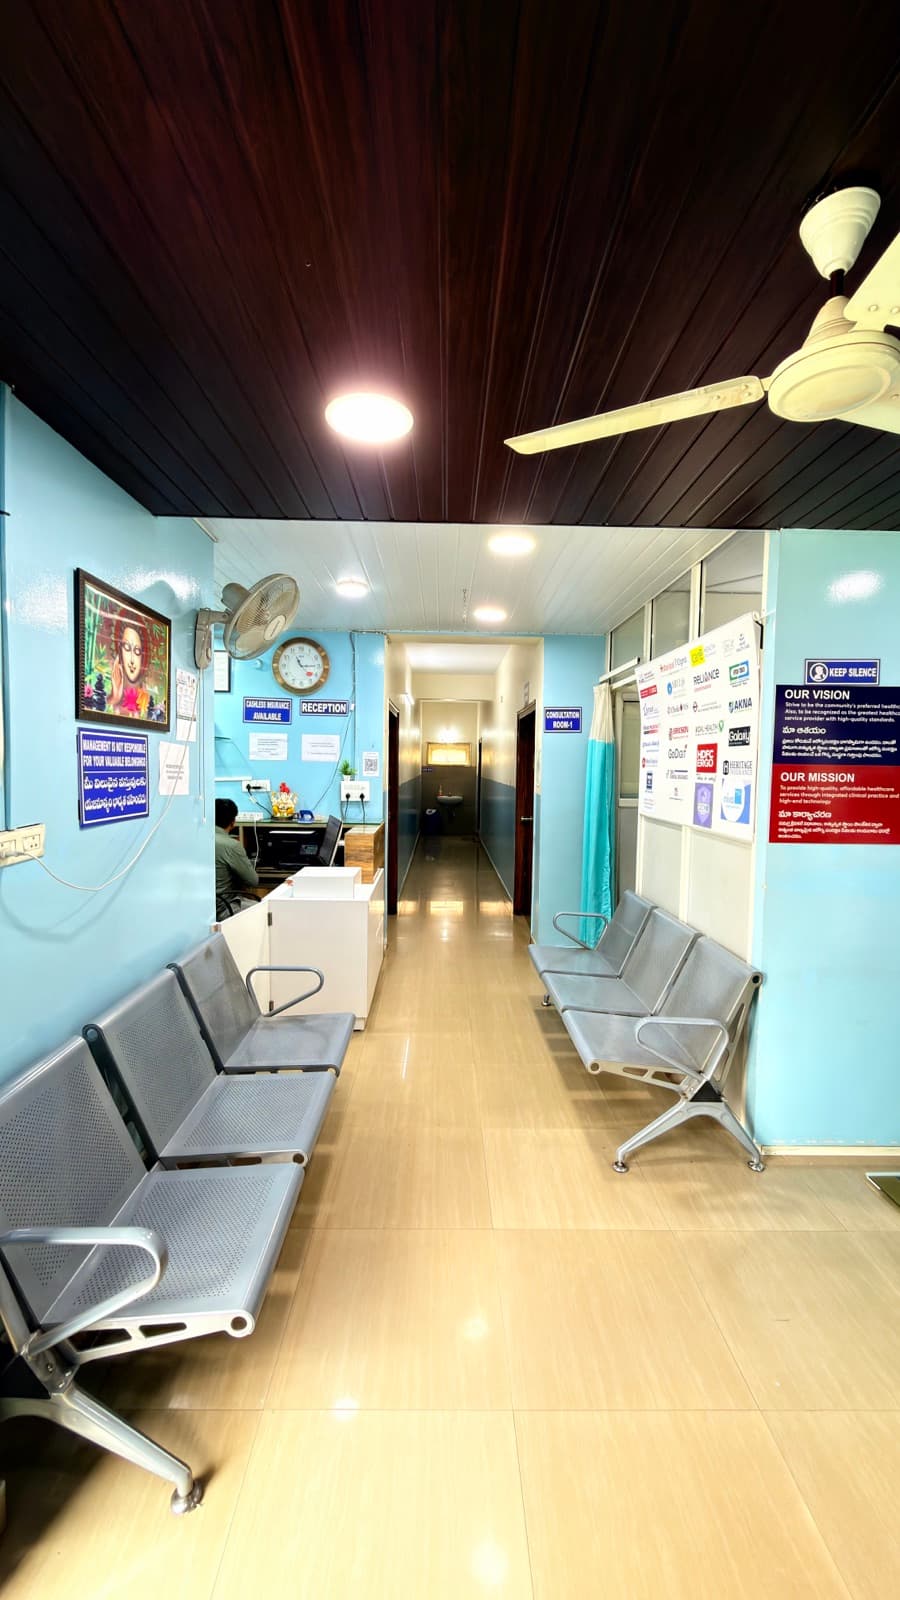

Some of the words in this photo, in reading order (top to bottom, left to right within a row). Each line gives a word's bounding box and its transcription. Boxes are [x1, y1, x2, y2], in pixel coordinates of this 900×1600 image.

[829, 668, 847, 677] KEEP
[848, 668, 877, 678] SILENCE
[785, 690, 810, 699] OUR
[812, 690, 850, 700] VISION
[302, 703, 346, 712] RECEPTION
[734, 697, 752, 710] AKNA
[253, 712, 282, 720] AVAILABLE
[82, 740, 111, 752] MANAGEMENT
[116, 742, 124, 752] NOT
[697, 749, 714, 758] HDFC
[83, 755, 92, 766] FOR
[92, 756, 104, 766] YOUR
[105, 756, 124, 766] VALUABLE
[696, 758, 714, 767] ERGO
[780, 772, 805, 782] OUR
[808, 772, 855, 782] MISSION
